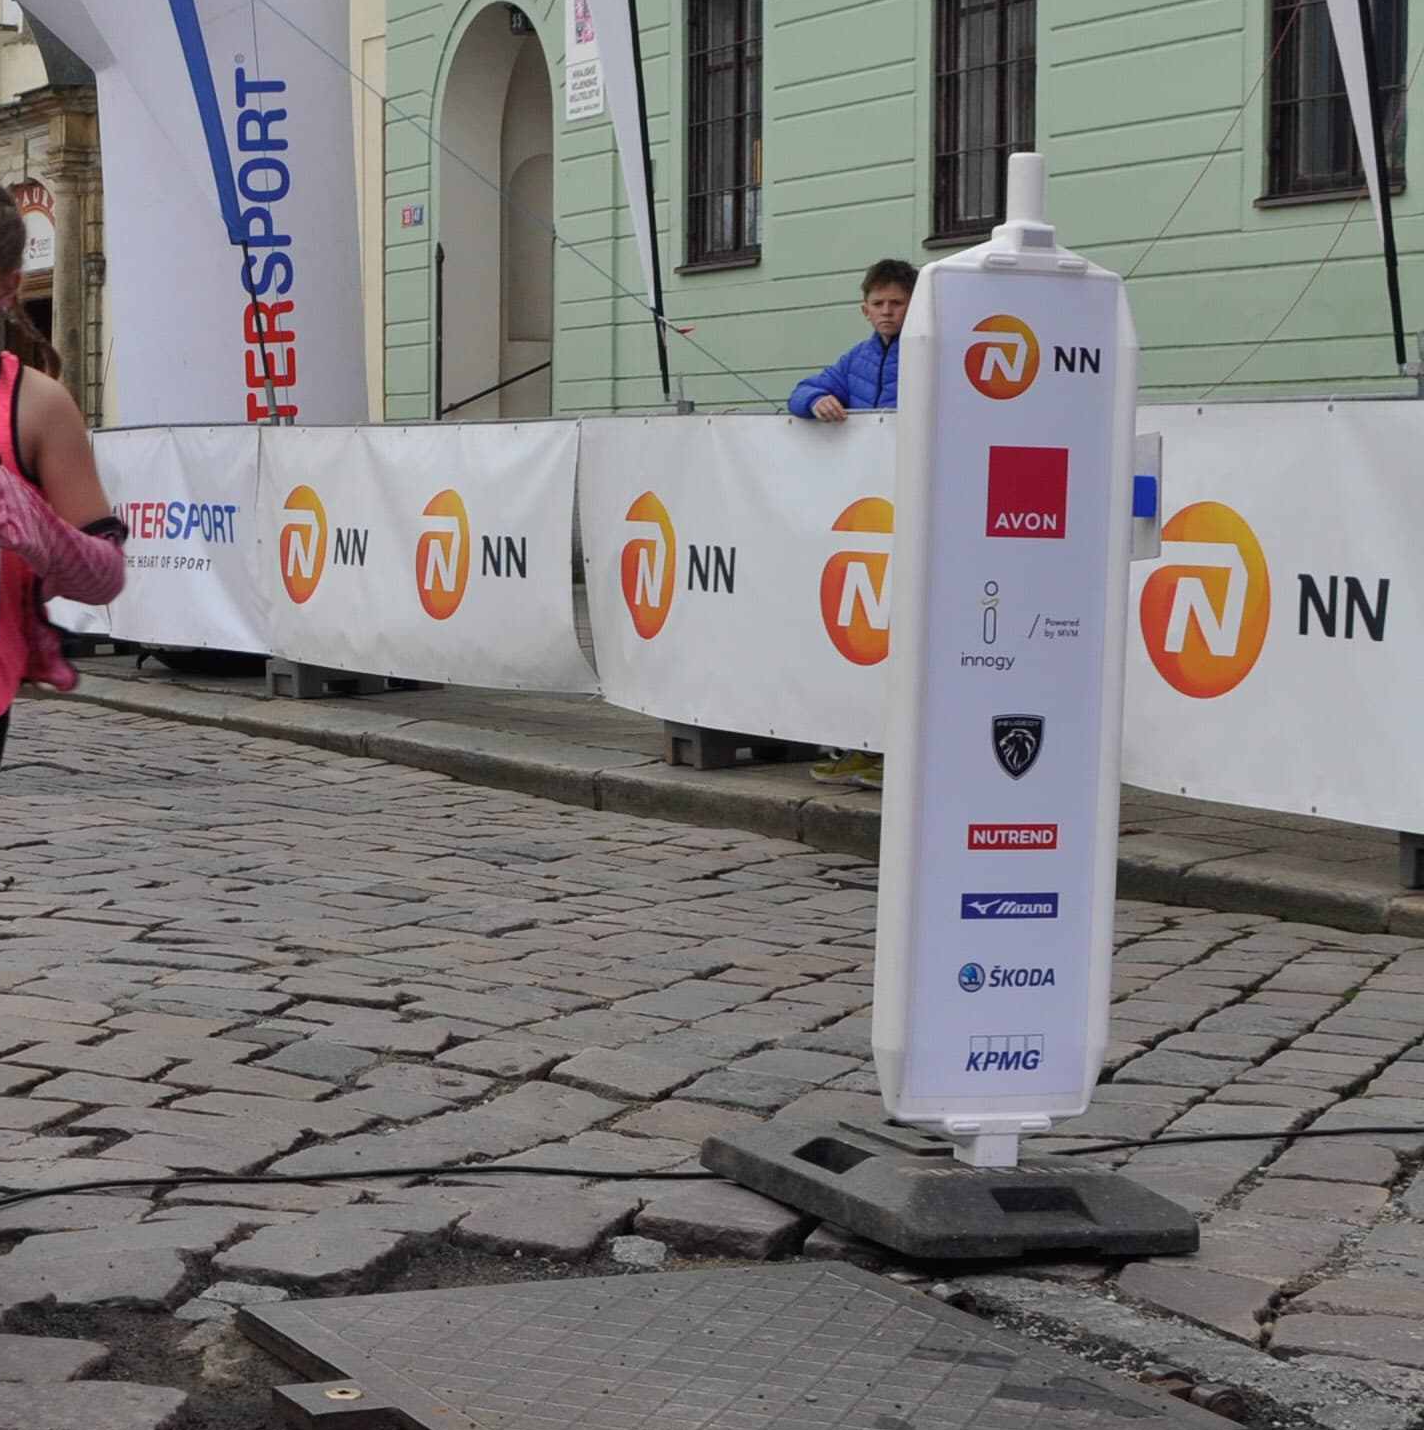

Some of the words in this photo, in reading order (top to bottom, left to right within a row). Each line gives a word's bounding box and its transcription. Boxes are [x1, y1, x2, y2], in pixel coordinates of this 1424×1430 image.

[235, 67, 298, 422] TERSPORT
[1053, 345, 1101, 374] NN
[994, 513, 1057, 530] AVON
[333, 527, 369, 567] NN
[482, 536, 527, 579] NN
[138, 555, 159, 569] HEART
[161, 556, 171, 569] OF
[174, 556, 211, 572] SPORT
[688, 545, 737, 595] NN
[1297, 573, 1390, 642] NN
[960, 652, 1015, 670] innogy
[972, 829, 1054, 845] NUTREND
[988, 965, 1056, 988] ŠKODA
[965, 1049, 1040, 1072] KPMG
